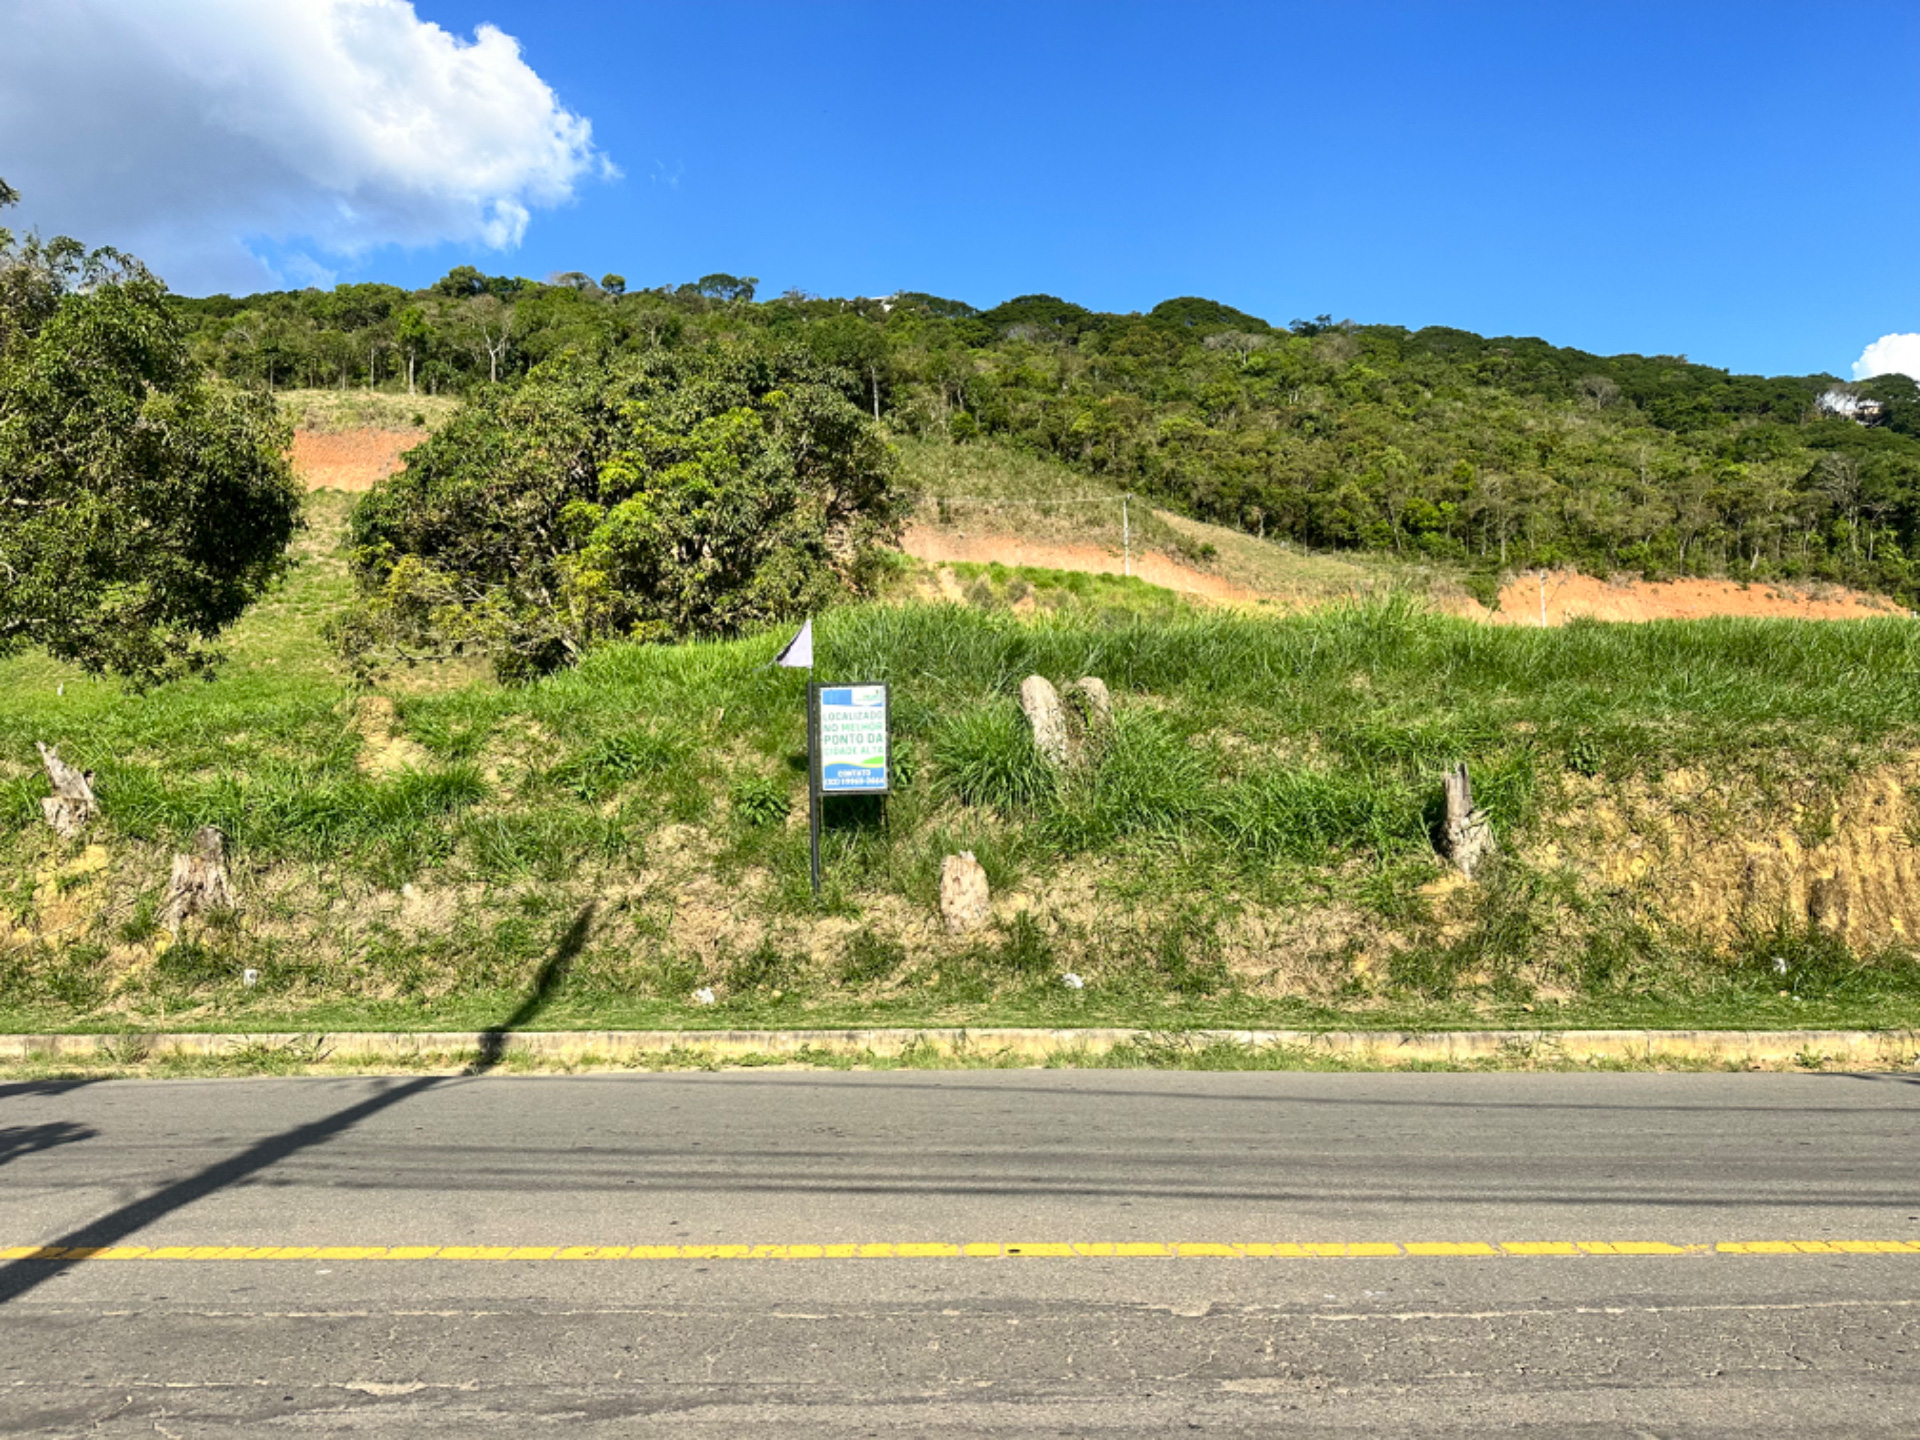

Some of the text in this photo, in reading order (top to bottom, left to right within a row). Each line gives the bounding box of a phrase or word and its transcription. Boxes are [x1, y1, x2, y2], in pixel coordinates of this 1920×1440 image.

[824, 732, 883, 745] PONTO DA
[824, 746, 857, 755] CIDADE
